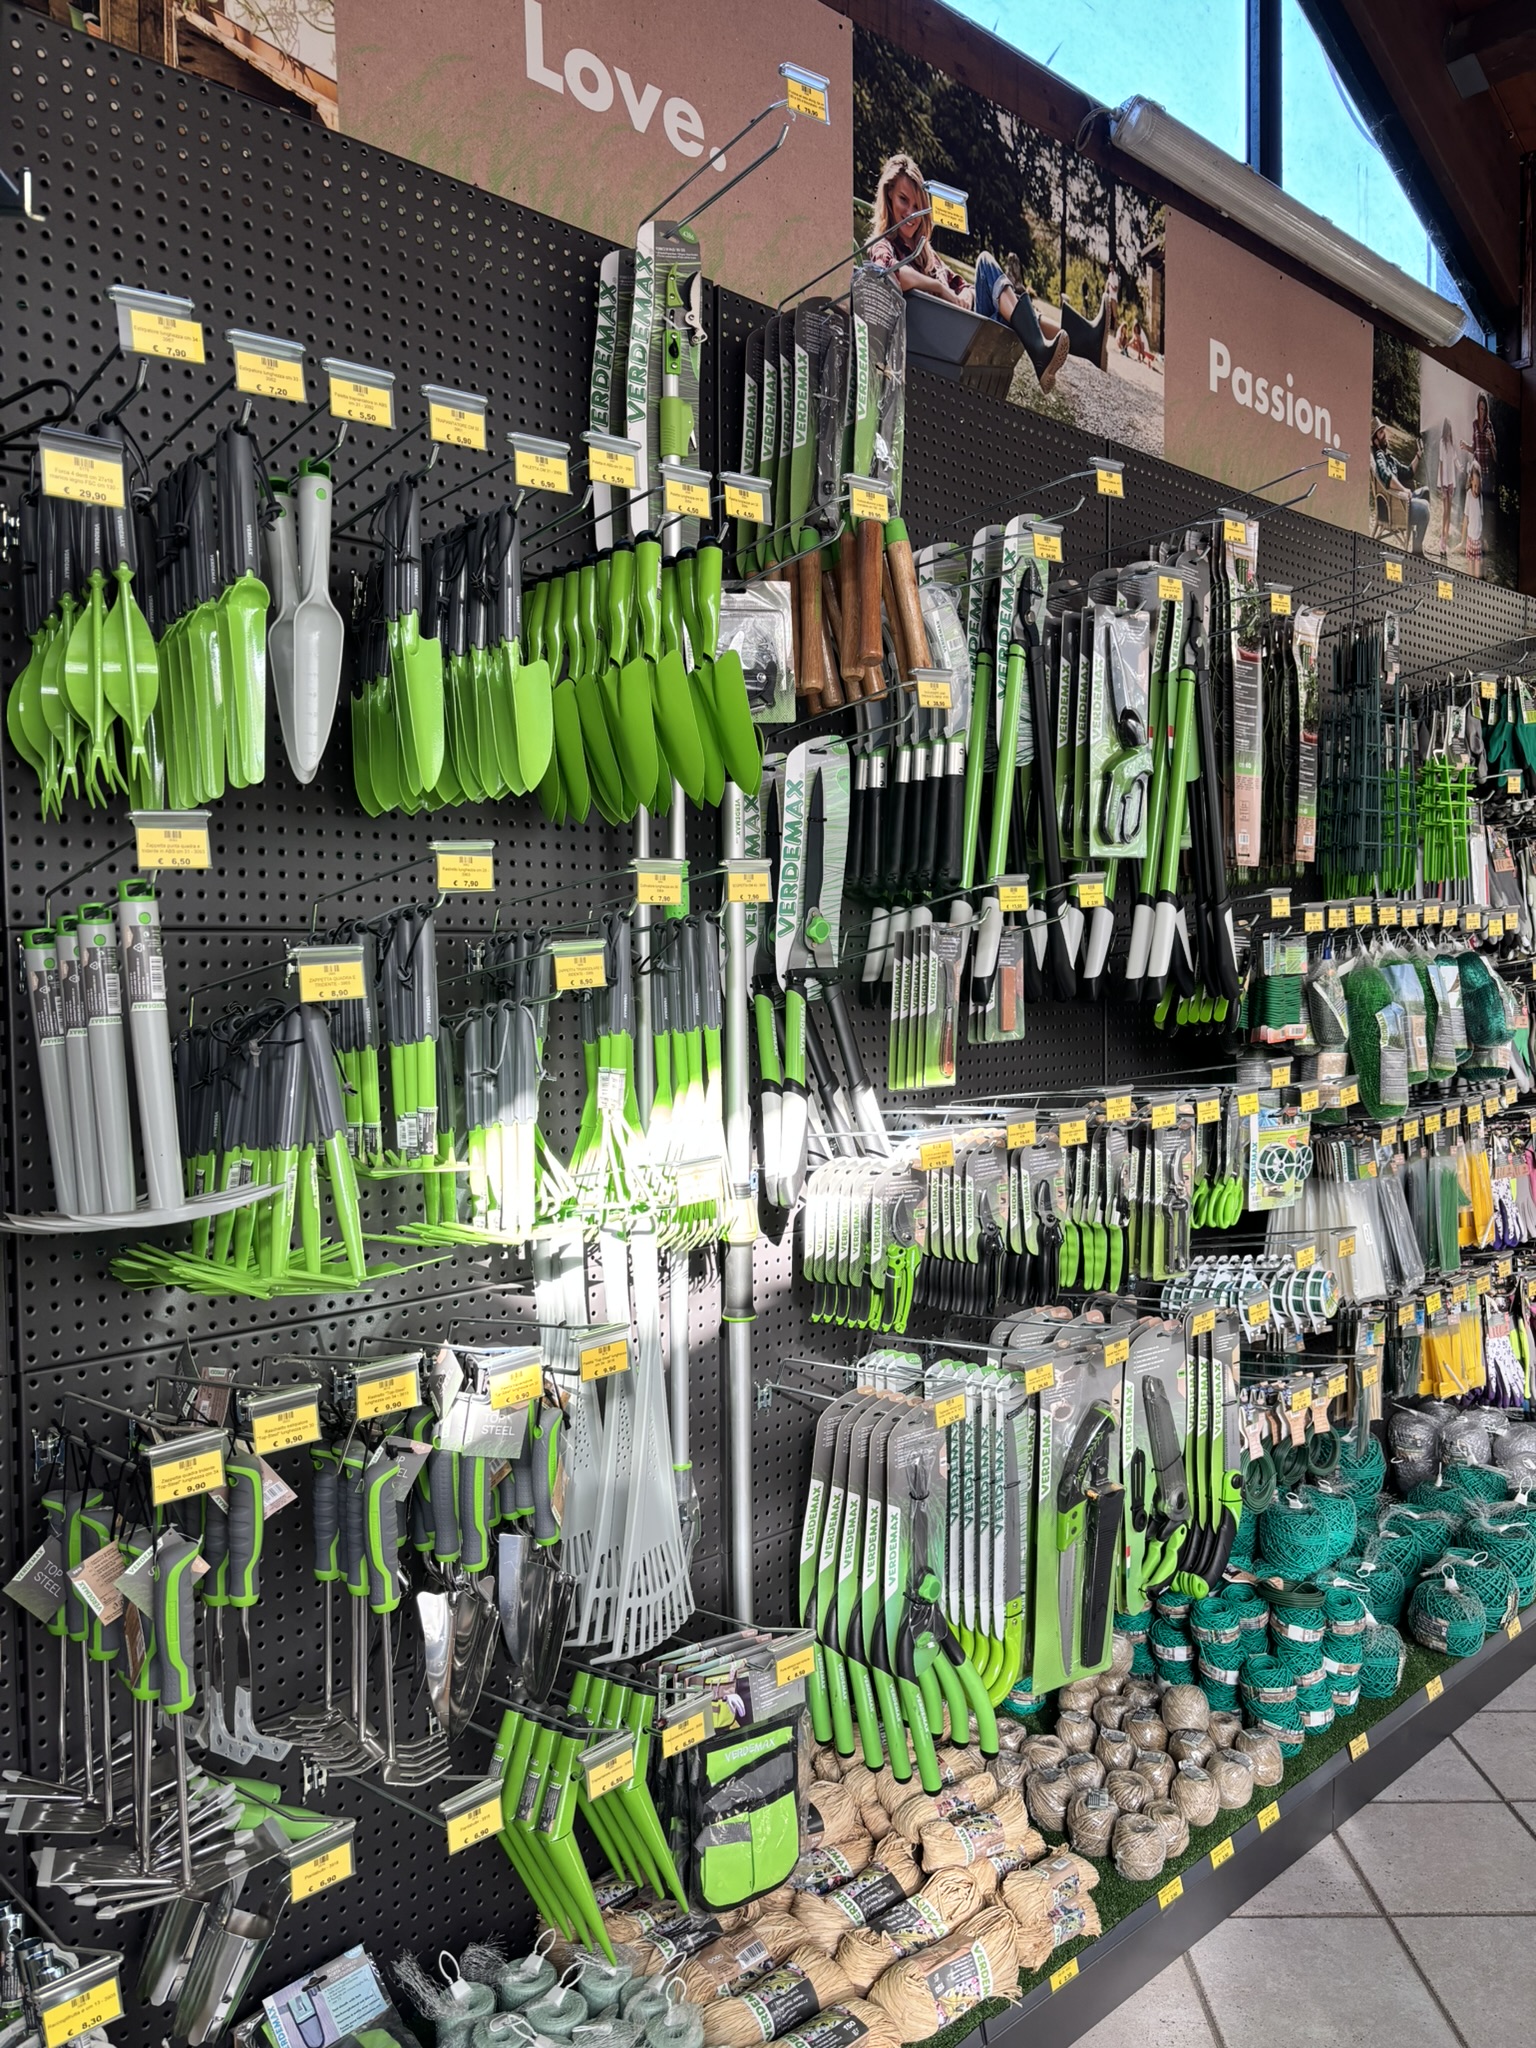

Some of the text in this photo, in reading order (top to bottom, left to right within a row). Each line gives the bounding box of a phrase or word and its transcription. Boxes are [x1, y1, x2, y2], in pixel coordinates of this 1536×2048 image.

[524, 0, 727, 173] Love.
[166, 346, 187, 358] 7,90
[626, 251, 653, 424] VERDEMAX
[856, 323, 868, 417] VERDEMAX
[268, 385, 288, 397] 7,20
[780, 362, 792, 455] VERDEMAX
[795, 353, 809, 445] VERDEMAX
[1208, 337, 1342, 449] Passion.
[359, 411, 377, 422] 5,50
[744, 384, 757, 471] VERDEMAX
[762, 368, 777, 462] VERDEMAX
[456, 435, 472, 445] 6,90
[79, 488, 108, 502] 29,90
[540, 480, 556, 489] 6,90
[610, 475, 625, 484] 5,50
[686, 506, 699, 515] 4,50
[742, 511, 755, 519] 4,50
[117, 515, 126, 549] VERDEMAX
[246, 524, 254, 556] VERDEMAX
[998, 546, 1017, 701] VERDEMAX
[1154, 600, 1169, 669] VERDEMA
[1058, 663, 1070, 743] VERDEMAX
[1077, 660, 1089, 742] VERDEMAX
[170, 857, 192, 868] 6,50
[776, 779, 804, 939] VERDEMAX
[463, 880, 479, 888] 7,90
[658, 895, 671, 903] 7,90
[330, 988, 350, 998] 8,90
[579, 977, 594, 987] 8,90
[893, 963, 901, 1013] VERDEMAX
[902, 962, 911, 1012] VERDEMAX
[912, 959, 920, 1009] VERDEMAX
[920, 958, 928, 1008] VERDEMAX
[929, 956, 938, 1007] VERDEMAX
[1250, 1141, 1258, 1188] VERDEMAX
[852, 1202, 860, 1255] VERDEMAX
[872, 1203, 881, 1256] VERDEMAX
[602, 1364, 617, 1374] 9,90
[385, 1400, 402, 1411] 9,90
[514, 1391, 531, 1401] 9,90
[1188, 1358, 1196, 1432] VERDEMAX
[1200, 1358, 1208, 1433] VERDEMAX
[1213, 1362, 1222, 1436] VERDEMAX
[285, 1433, 304, 1446] 9,90
[480, 1424, 516, 1437] STEEL
[1124, 1384, 1135, 1463] VERDEMAX
[963, 1419, 974, 1531] VERDEMAX
[1040, 1413, 1052, 1497] VERDEMAX
[186, 1481, 207, 1494] 9,90
[979, 1423, 989, 1535] VERDEMAX
[804, 1485, 822, 1552] VERDEMAX
[823, 1493, 842, 1561] VERDEMAX
[843, 1499, 859, 1571] VERDEMAX
[866, 1506, 879, 1579] VERDEMAX
[887, 1512, 899, 1588] VERDEMAX
[15, 1548, 45, 1582] VERDEMAX
[33, 1570, 62, 1598] STEEL
[42, 1559, 64, 1579] TOP
[79, 1581, 103, 1613] VERDEMAX
[817, 1652, 827, 1690] VERDEMAX
[838, 1662, 847, 1700] VERDEMAX
[863, 1674, 875, 1713] VERDEMAX
[889, 1683, 902, 1723] VERDEMAX
[915, 1692, 931, 1734] VERDEMAX
[682, 1737, 696, 1749] 6,50
[723, 1737, 777, 1763] VERDEMAX
[609, 1775, 625, 1787] 6,50
[473, 1827, 490, 1840] 6,90
[319, 1874, 337, 1887] 6,90
[974, 1945, 992, 1998] VERDEM
[81, 2014, 103, 2030] 8,30
[267, 2005, 294, 2048] ERDEMAX
[743, 1992, 775, 2041] VERDEM
[842, 2019, 857, 2032] 150
